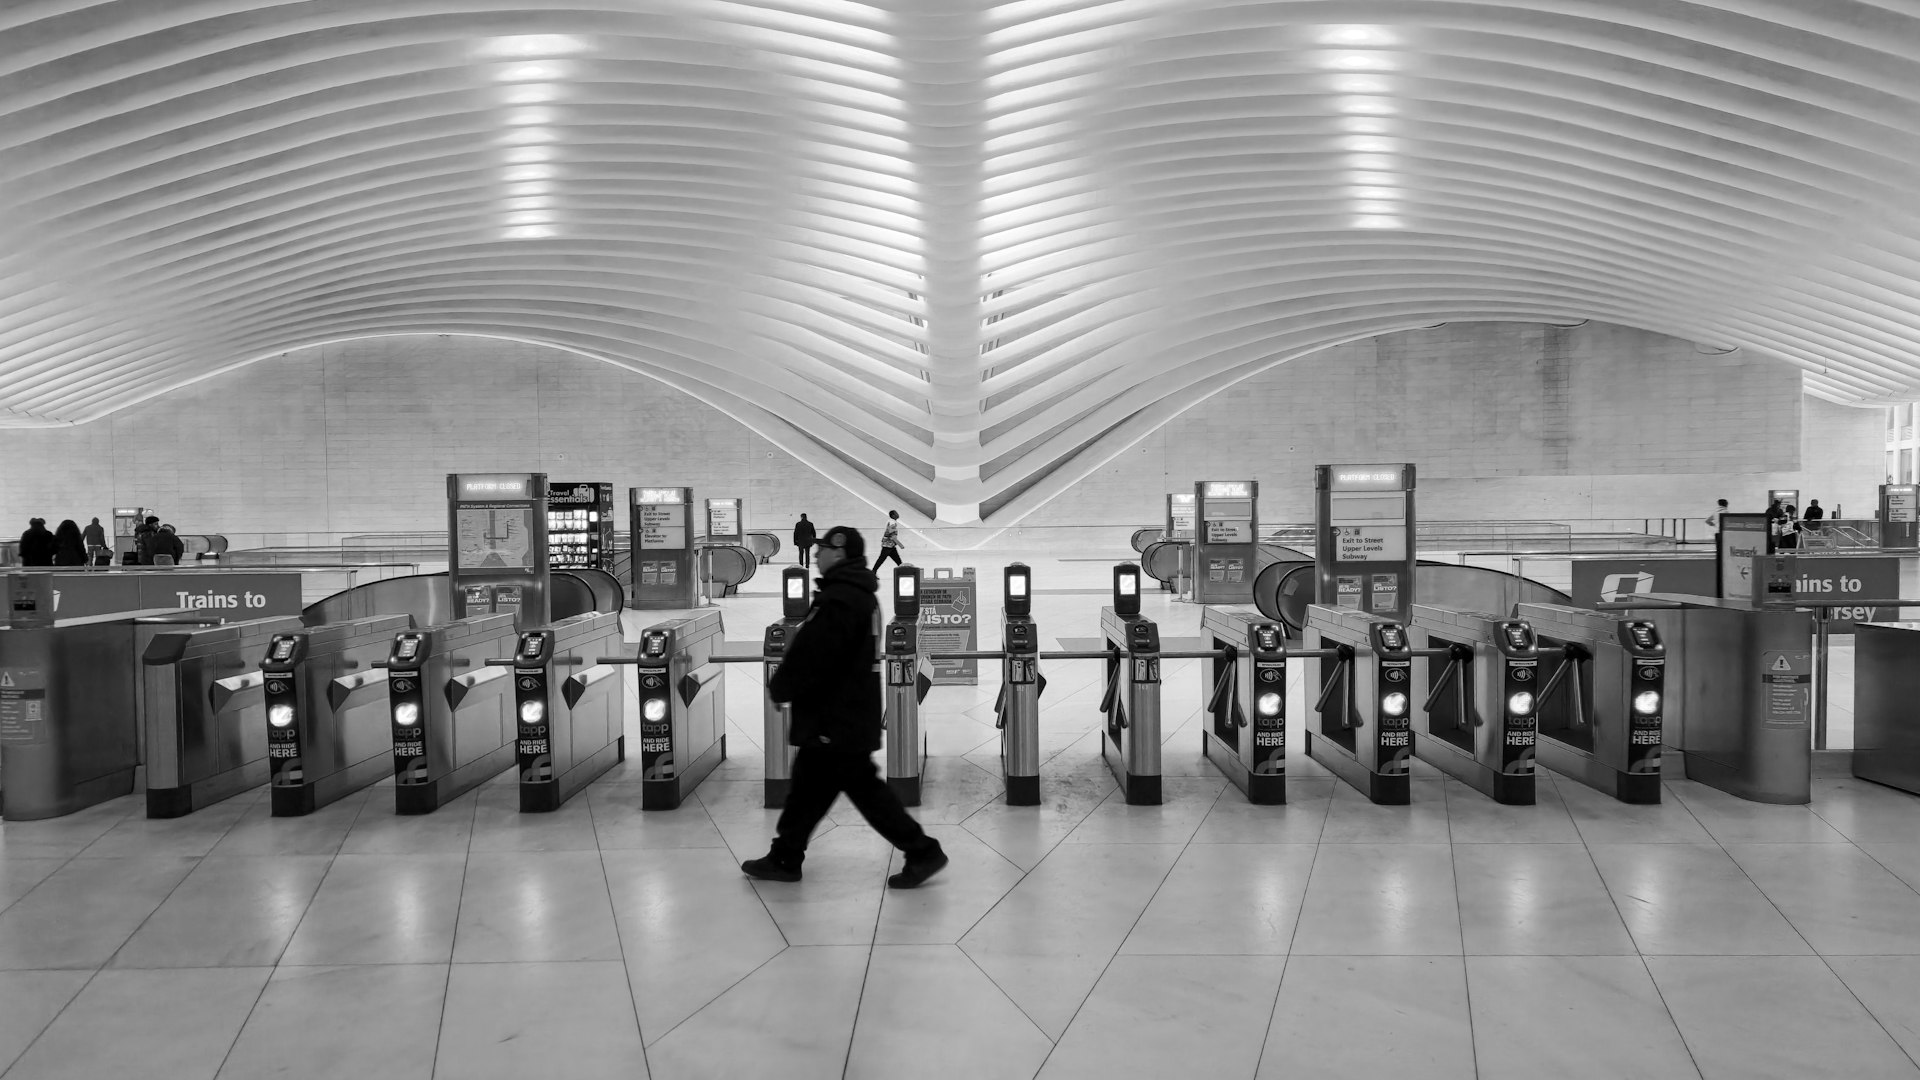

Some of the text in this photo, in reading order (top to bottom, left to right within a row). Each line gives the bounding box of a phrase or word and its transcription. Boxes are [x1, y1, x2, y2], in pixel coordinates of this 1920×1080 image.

[1340, 473, 1395, 481] PLATFORM CLOSED
[466, 482, 521, 491] PLATFORM CLOSED
[548, 493, 588, 503] ssentials
[550, 489, 570, 497] Travel
[1796, 574, 1862, 593] ins to
[176, 589, 266, 609] Trains to
[924, 605, 937, 615] STÁ
[1829, 607, 1876, 623] rsey
[925, 614, 971, 624] ISTO?
[1257, 717, 1284, 729] tapp
[1382, 717, 1409, 729] tapp
[1508, 716, 1535, 728] tapp
[519, 724, 546, 737] tapp
[642, 722, 669, 734] tapp
[1256, 736, 1284, 747] HERE
[1381, 736, 1409, 746] HERE
[1506, 736, 1535, 745] HERE
[1632, 735, 1661, 745] HERE
[395, 747, 423, 756] HERE
[519, 745, 548, 754] HERE
[642, 743, 670, 752] HERE
[270, 748, 298, 758] HERE
